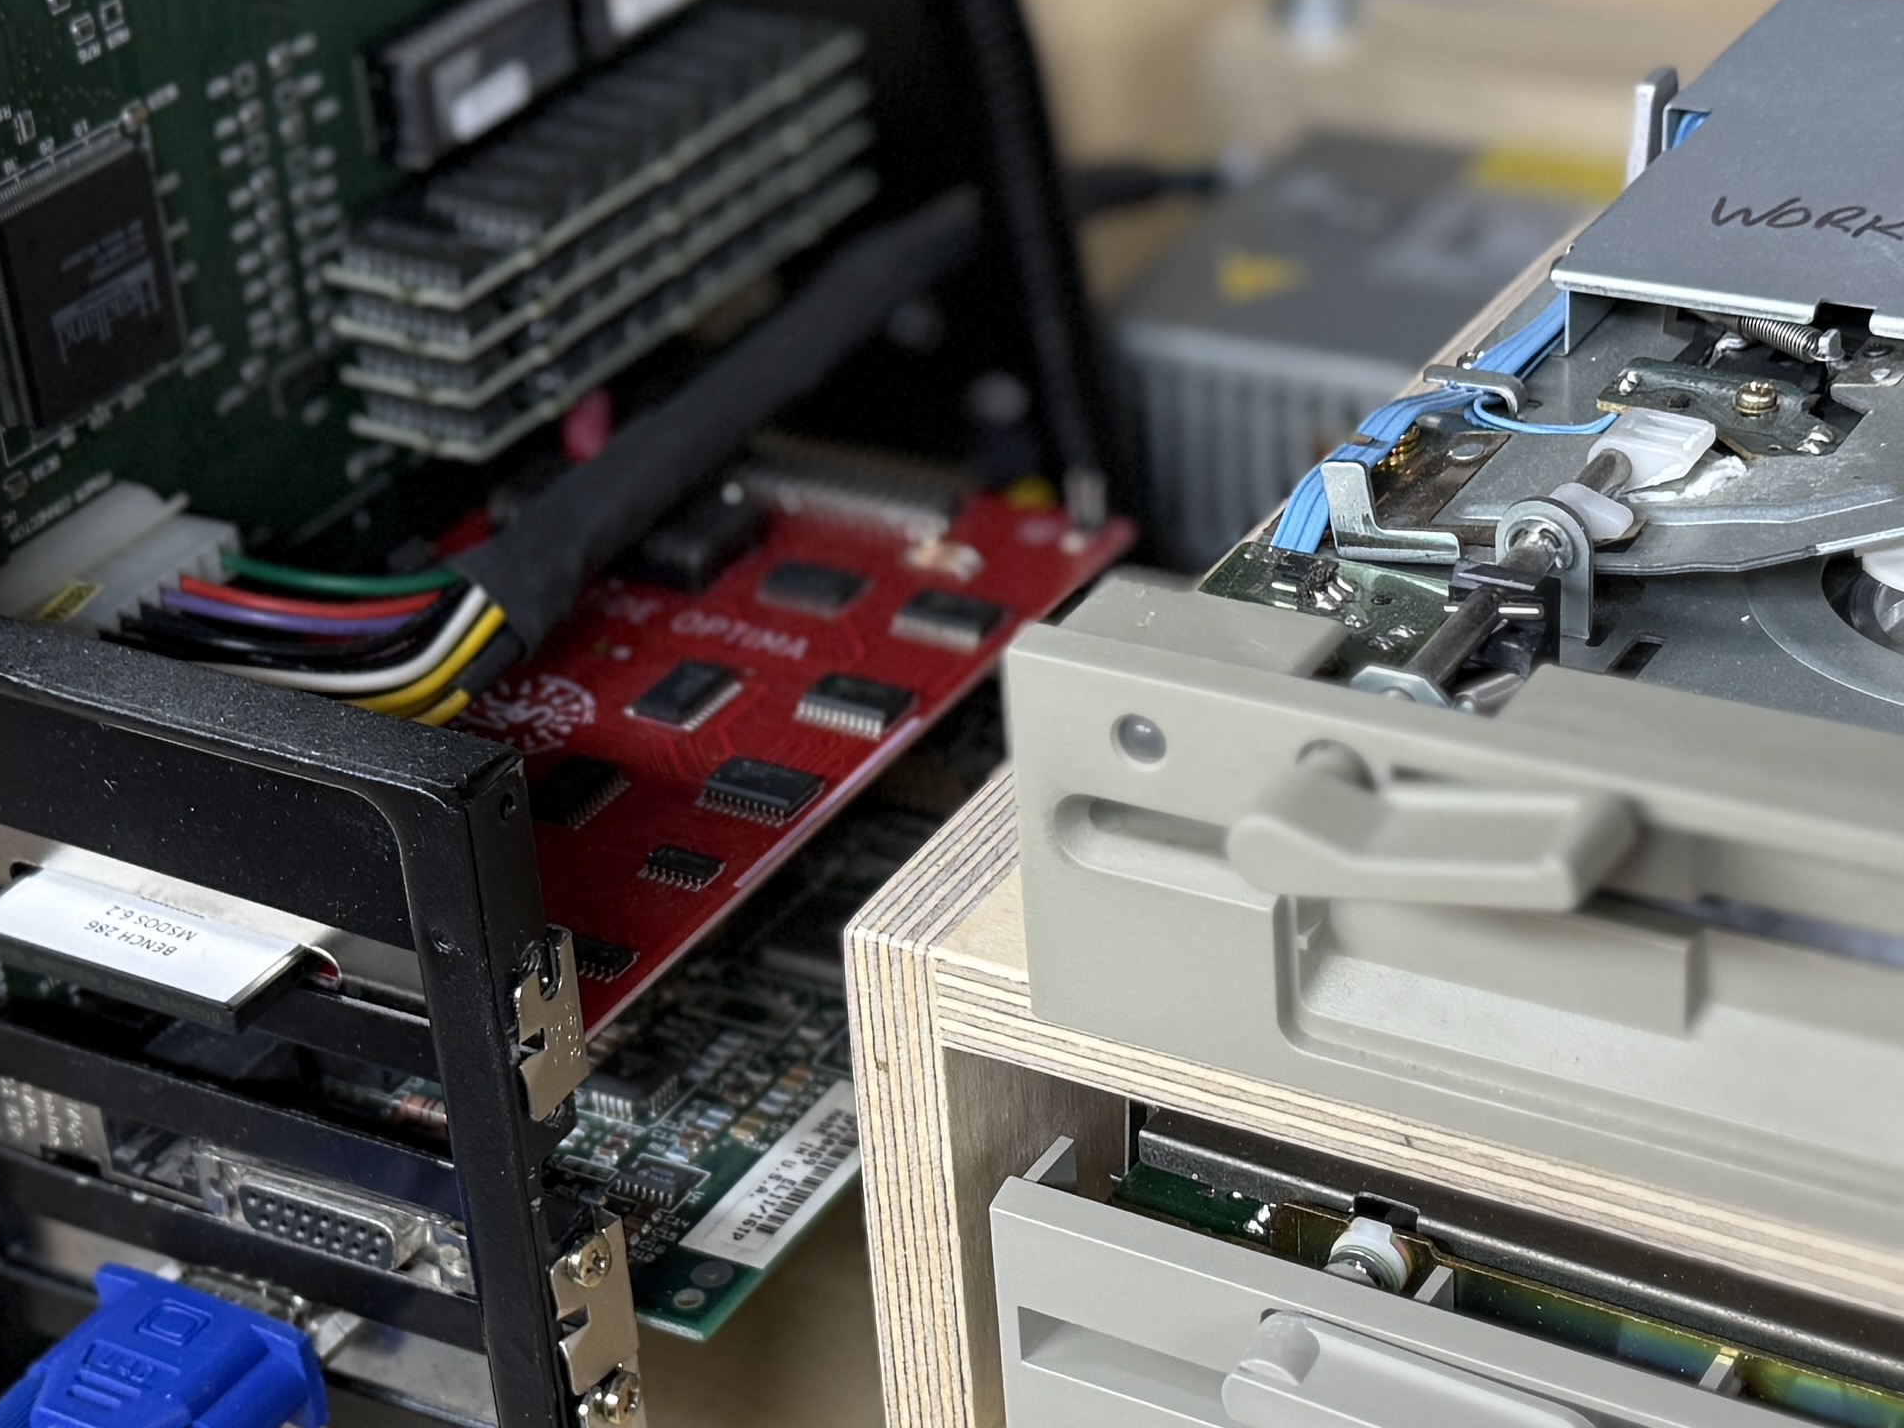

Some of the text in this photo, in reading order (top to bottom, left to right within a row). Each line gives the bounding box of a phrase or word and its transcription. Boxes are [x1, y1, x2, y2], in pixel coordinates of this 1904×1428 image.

[84, 920, 178, 957] BENCH 286
[105, 904, 198, 942] MSDOS 6.2
